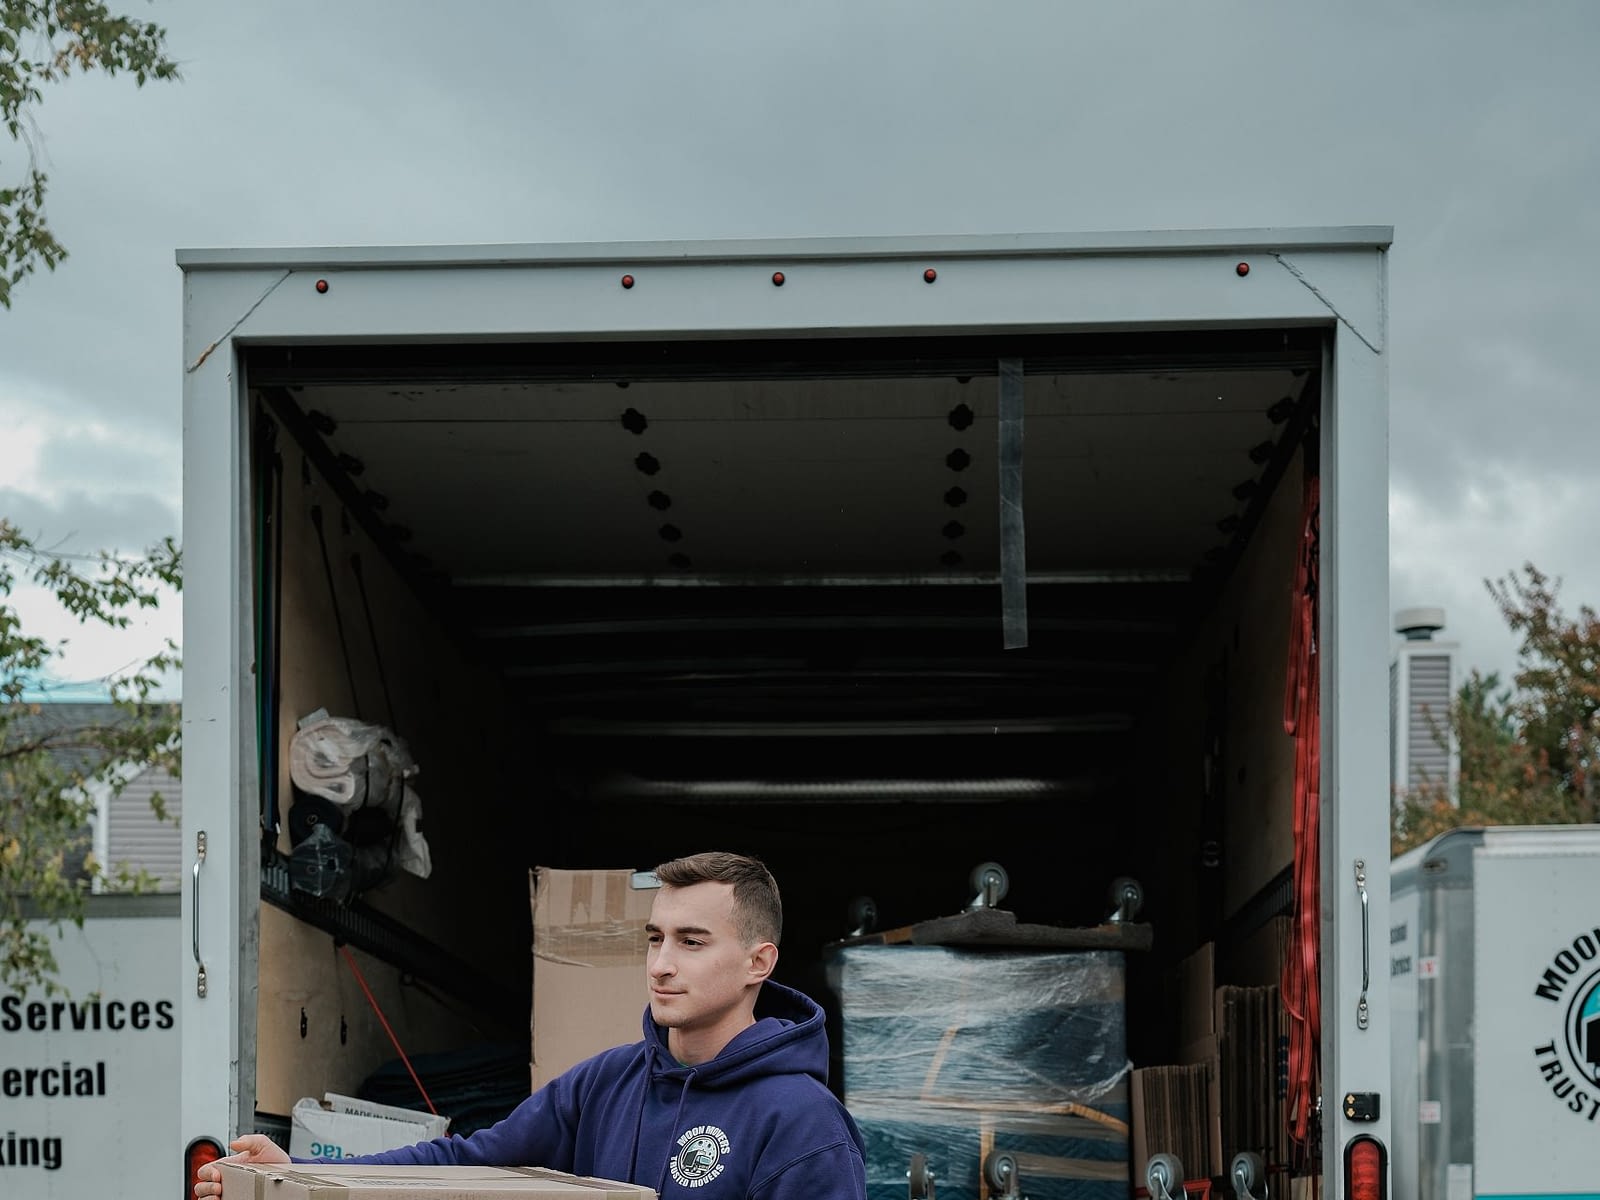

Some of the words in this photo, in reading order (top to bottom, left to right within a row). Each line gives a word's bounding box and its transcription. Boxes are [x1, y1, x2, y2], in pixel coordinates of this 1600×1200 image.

[1, 996, 174, 1032] Services
[2, 1062, 106, 1097] ercial
[0, 1132, 63, 1170] ing
[677, 1126, 705, 1147] MOON
[705, 1126, 731, 1154] MOVERS
[669, 1156, 689, 1187] TRUSTED
[690, 1164, 724, 1187] MOVERS
